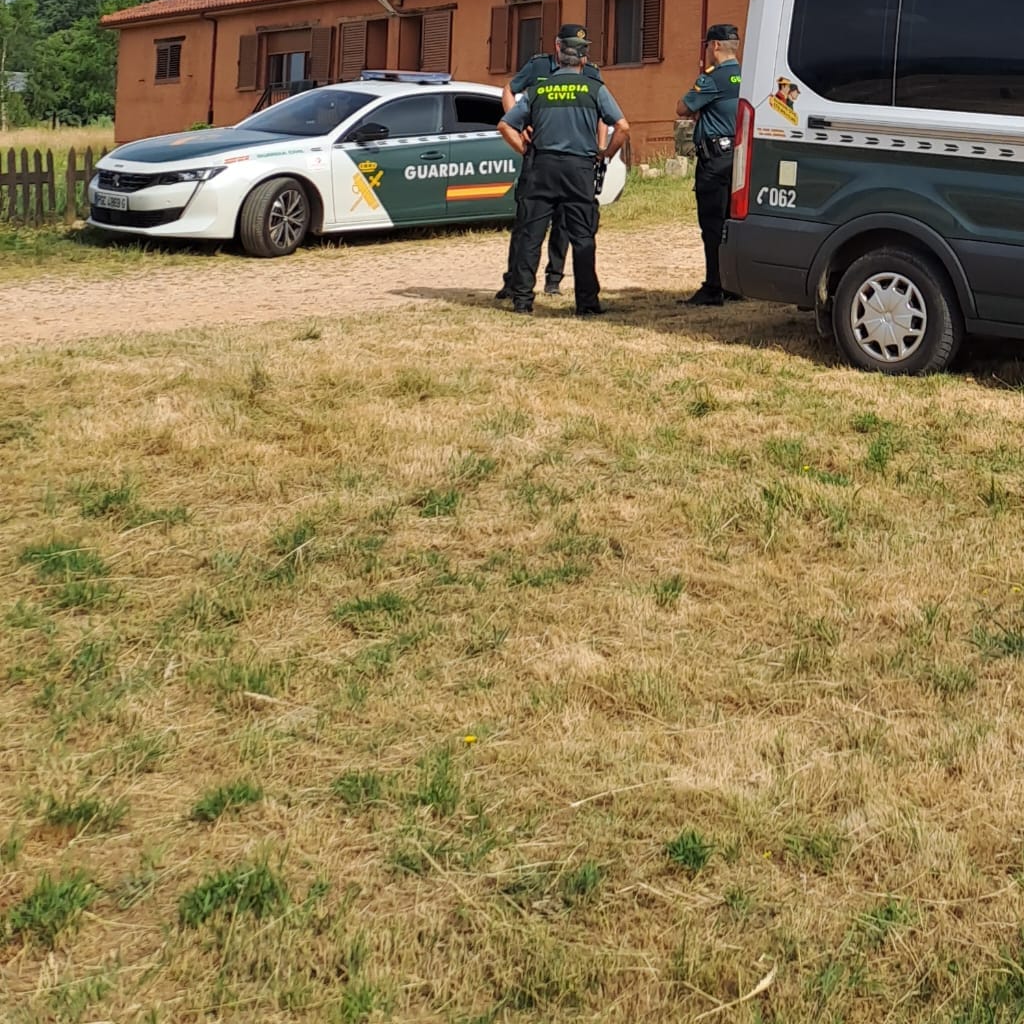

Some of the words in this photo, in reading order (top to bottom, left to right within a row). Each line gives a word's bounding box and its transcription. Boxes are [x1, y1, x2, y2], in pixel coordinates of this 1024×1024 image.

[537, 84, 589, 94] GUARDIA
[547, 92, 577, 100] CIVIL
[404, 161, 475, 180] GUARDIA
[479, 159, 516, 175] CIVIL
[769, 187, 797, 208] 062
